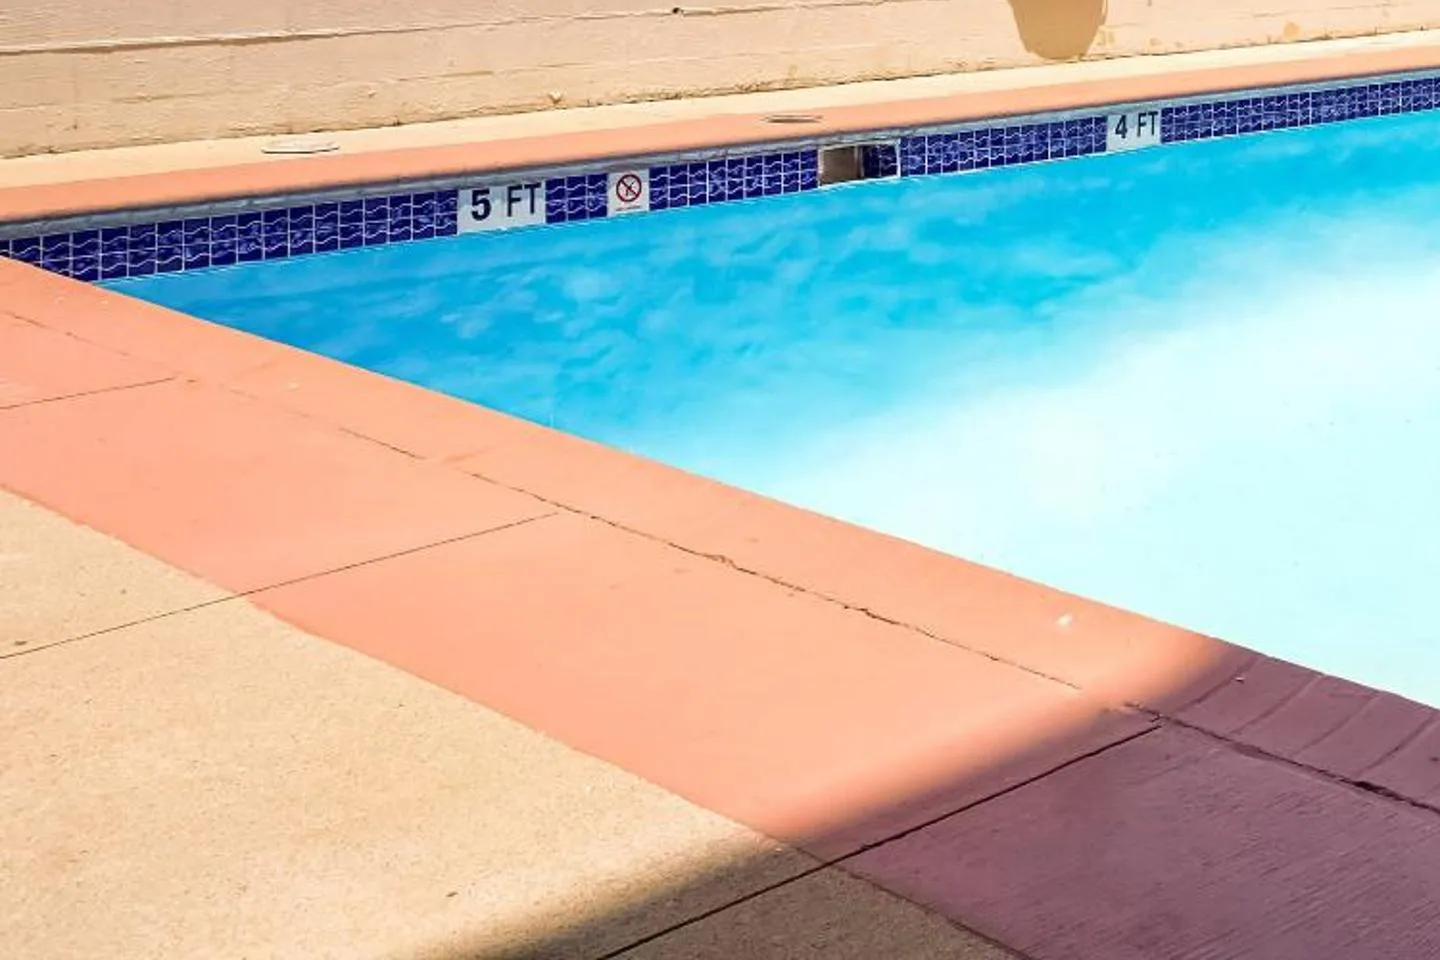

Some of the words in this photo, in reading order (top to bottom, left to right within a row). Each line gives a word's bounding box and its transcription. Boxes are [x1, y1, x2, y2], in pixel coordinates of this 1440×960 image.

[1115, 114, 1128, 139] 4
[1137, 111, 1159, 137] FT
[471, 189, 491, 221] 5
[507, 183, 541, 217] FT
